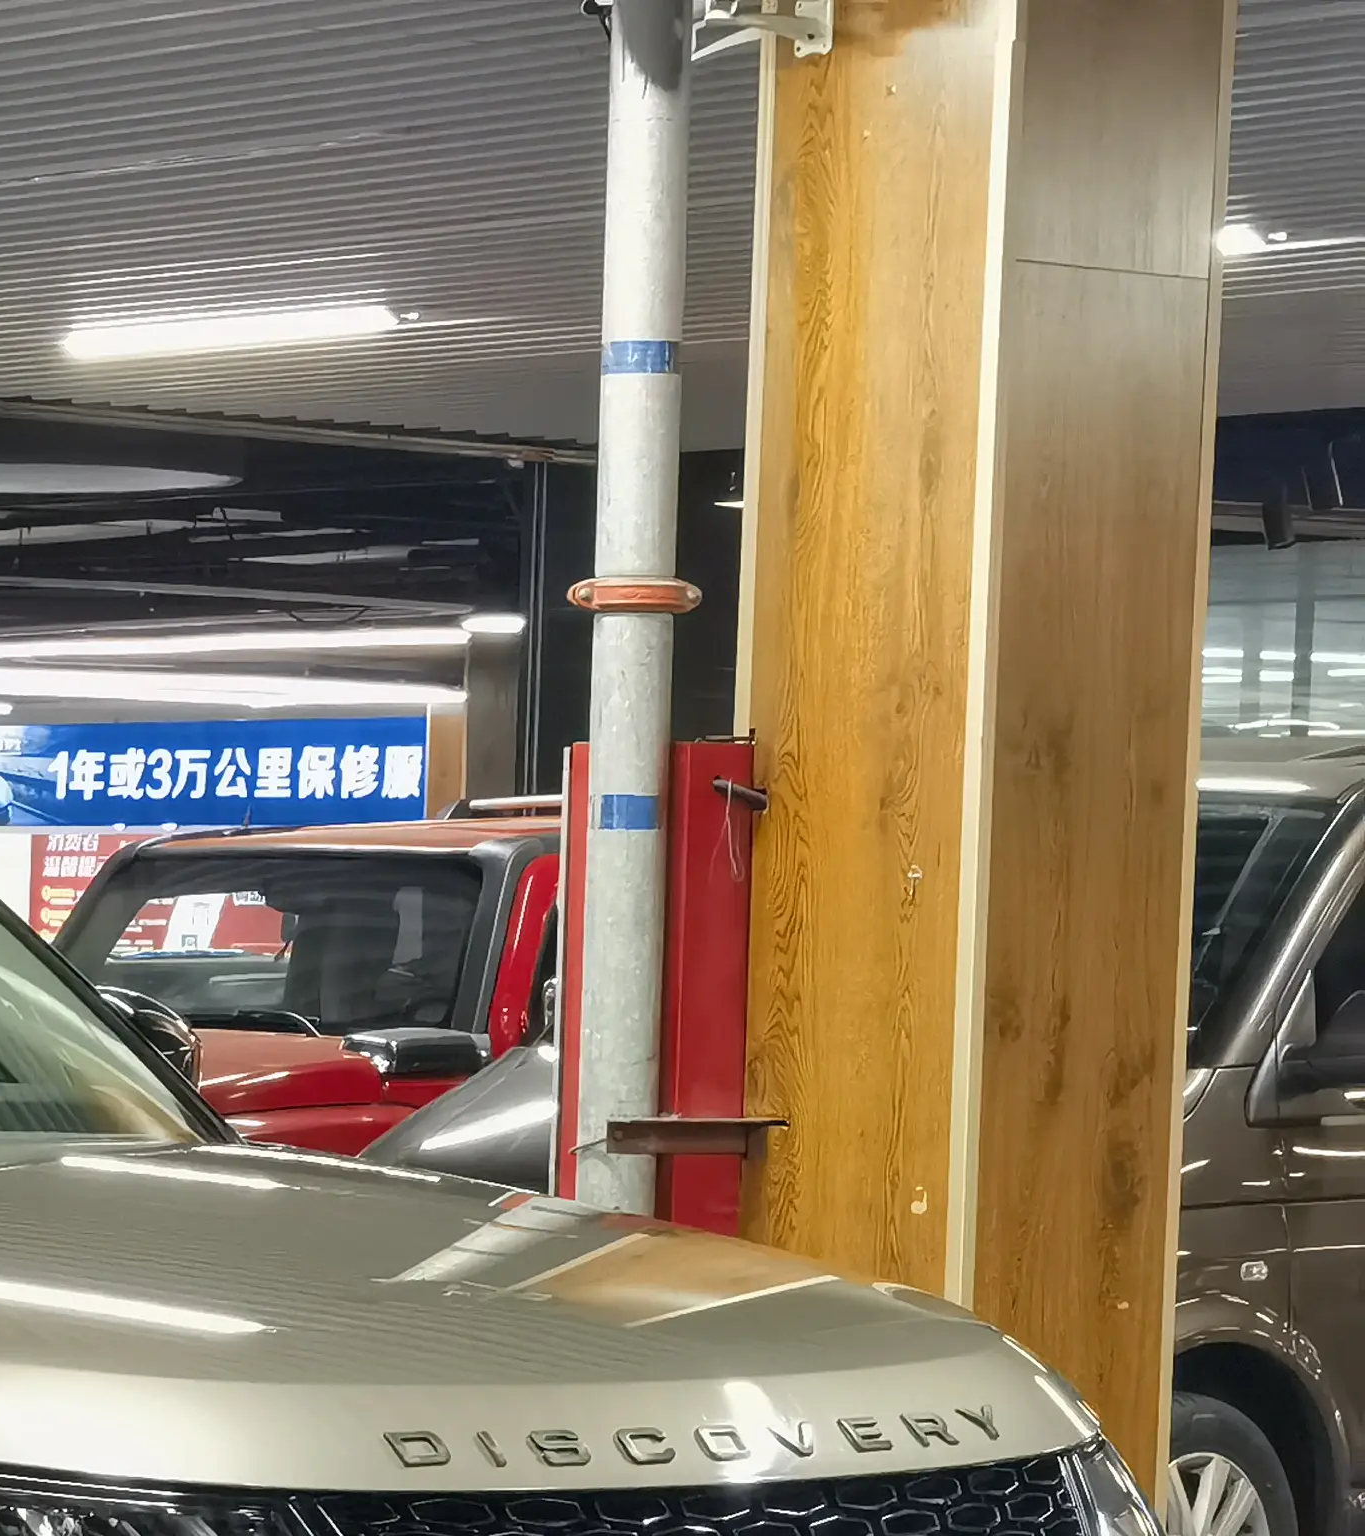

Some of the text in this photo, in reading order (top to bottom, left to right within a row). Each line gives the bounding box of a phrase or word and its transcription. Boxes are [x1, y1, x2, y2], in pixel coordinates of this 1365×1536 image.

[48, 744, 423, 801] 1年或3万公里保修服
[381, 1403, 1001, 1469] DISCOVERY
